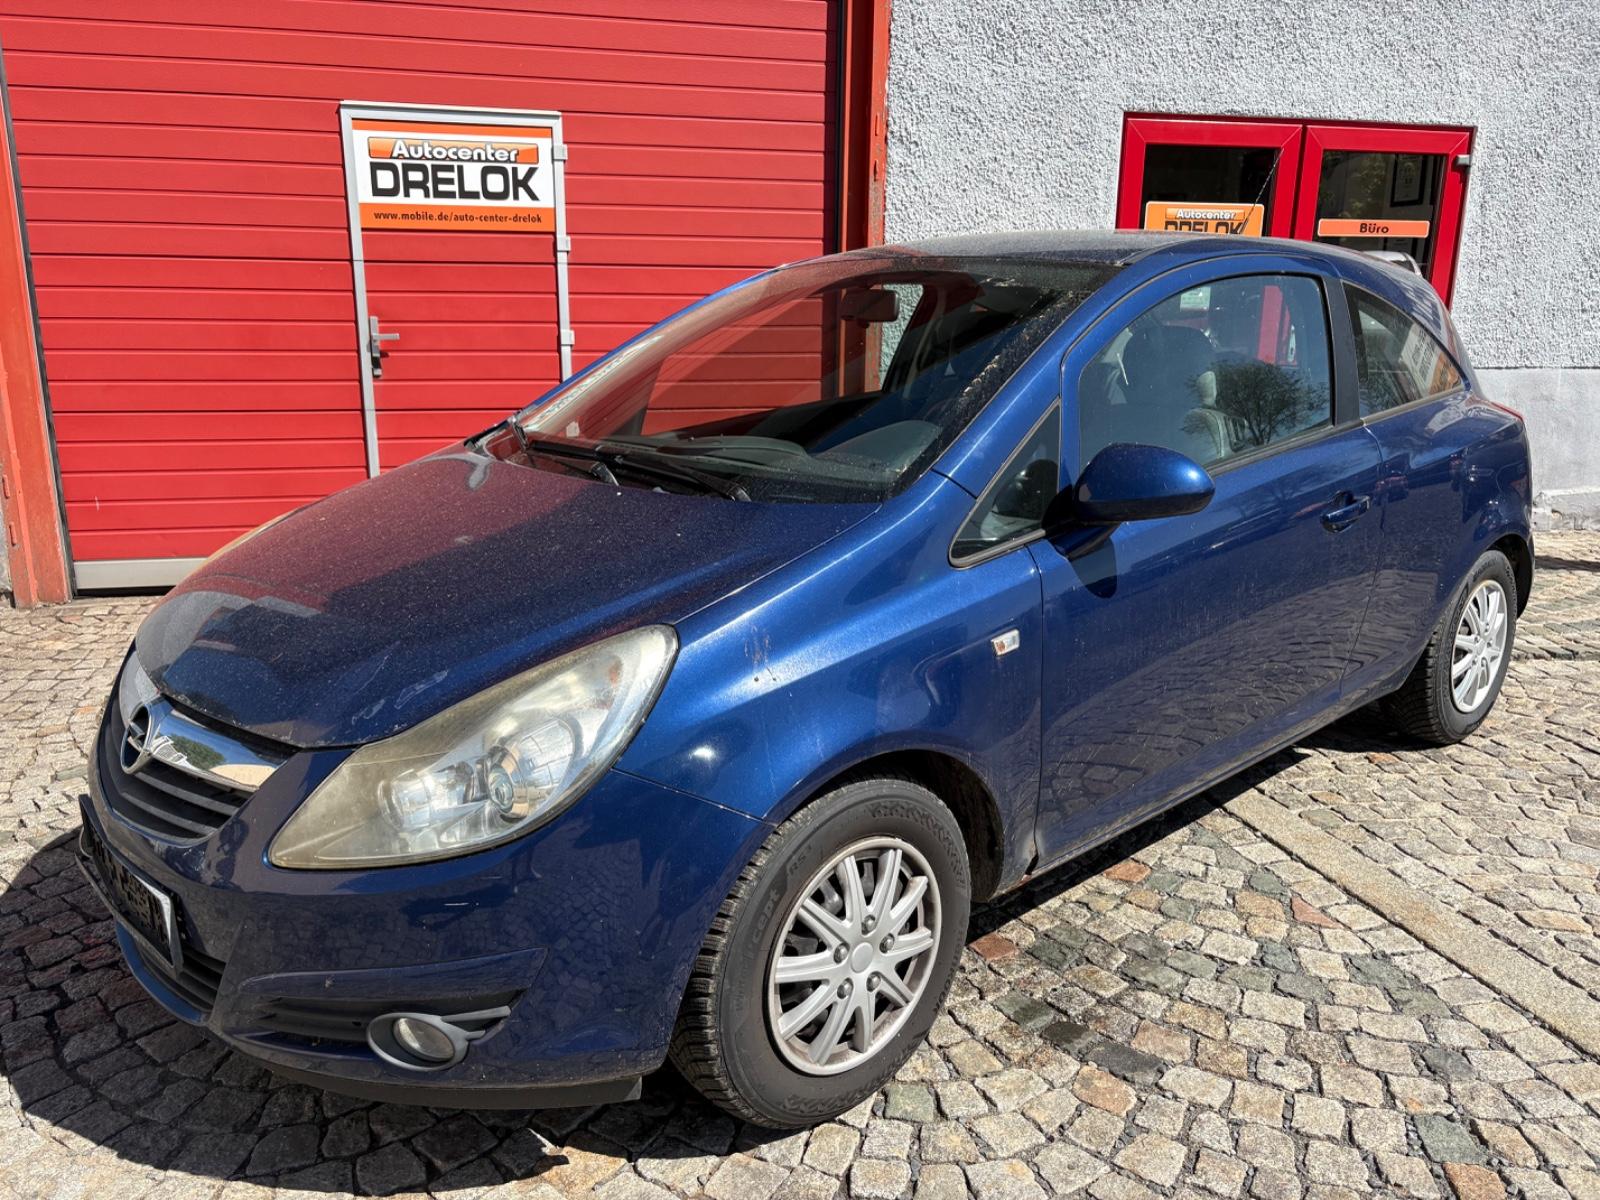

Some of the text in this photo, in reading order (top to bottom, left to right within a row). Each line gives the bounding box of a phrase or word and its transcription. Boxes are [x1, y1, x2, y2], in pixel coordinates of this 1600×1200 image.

[391, 139, 519, 162] Autocenter
[369, 161, 540, 201] DRELOK
[373, 211, 542, 223] www.mobile.de/auto-center-drelok
[1176, 208, 1236, 220] Autocenter
[1360, 223, 1389, 234] Büro
